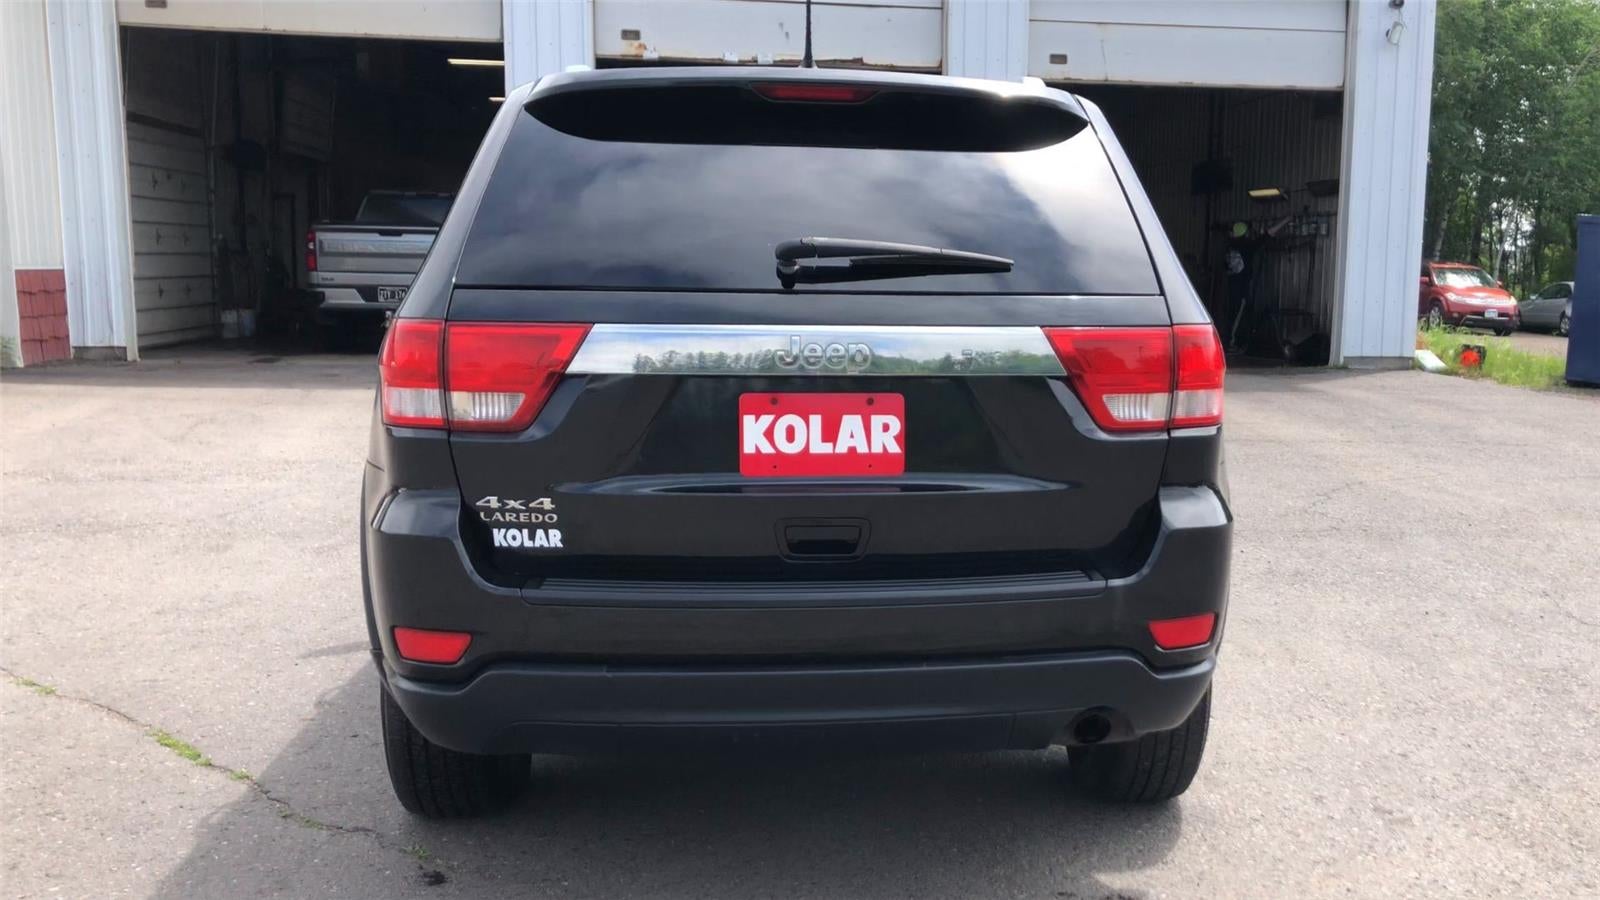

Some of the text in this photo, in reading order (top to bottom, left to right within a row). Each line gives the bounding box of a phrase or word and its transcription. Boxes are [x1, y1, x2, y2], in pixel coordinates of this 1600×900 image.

[775, 335, 872, 374] Jeep
[743, 414, 902, 454] KOLAR
[475, 496, 556, 510] 4x4
[480, 511, 558, 523] LAREDO
[492, 528, 563, 548] KOLAR
